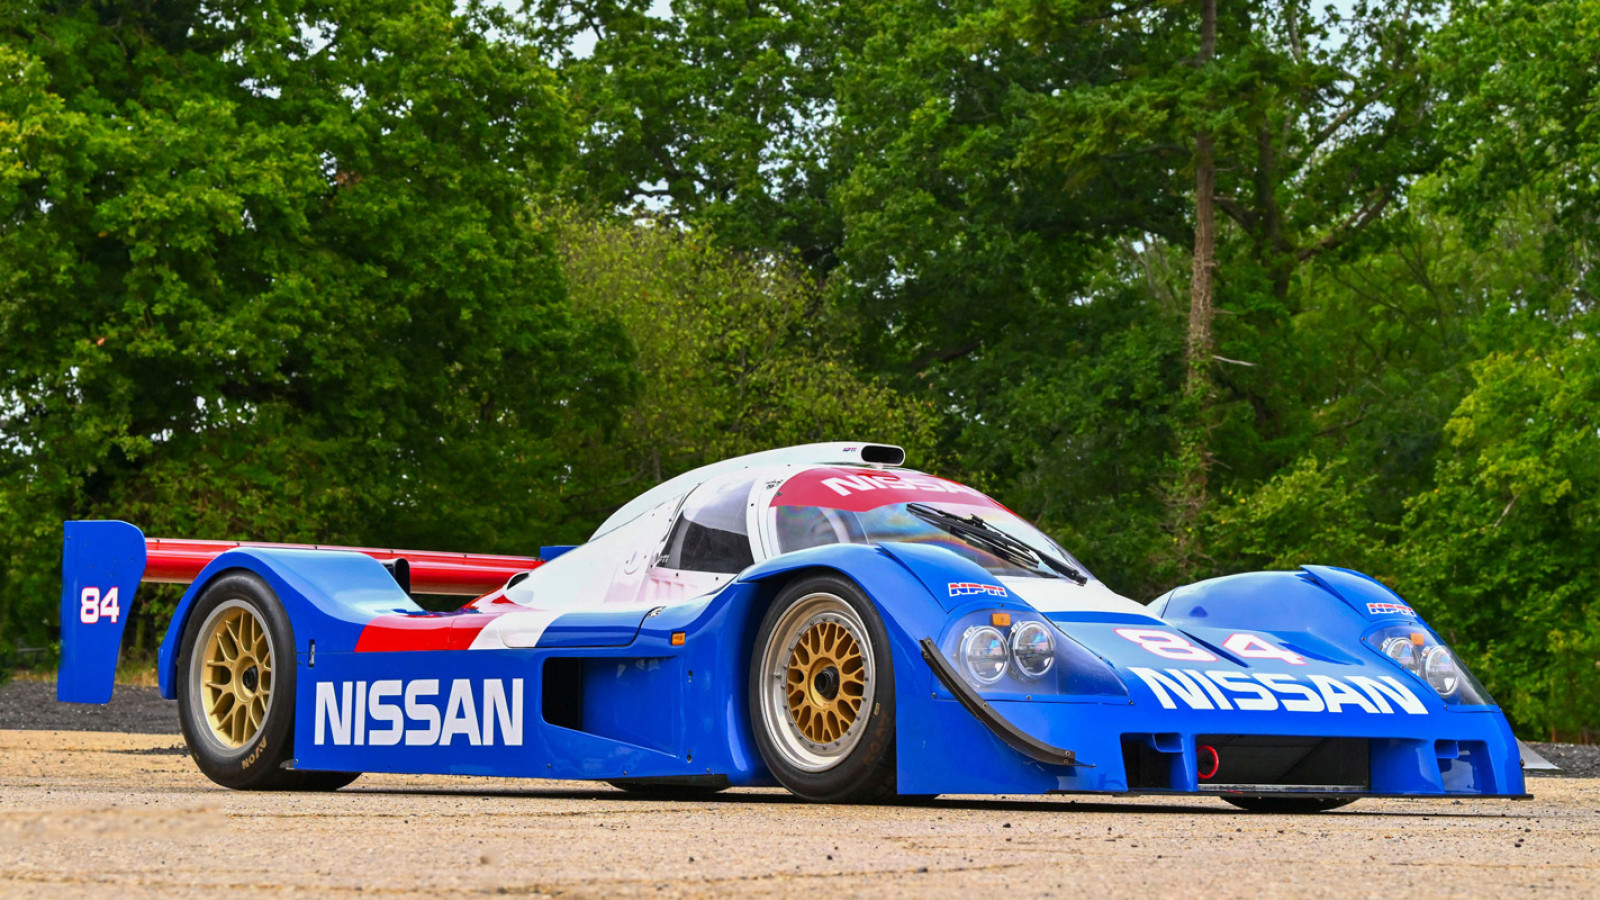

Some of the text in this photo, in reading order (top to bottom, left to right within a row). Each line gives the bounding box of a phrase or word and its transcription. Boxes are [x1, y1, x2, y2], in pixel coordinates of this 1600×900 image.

[80, 586, 120, 624] 84
[948, 583, 1008, 597] NPTI
[1366, 602, 1417, 617] NPTI
[1127, 666, 1429, 715] NISSAN
[314, 678, 524, 746] NISSAN
